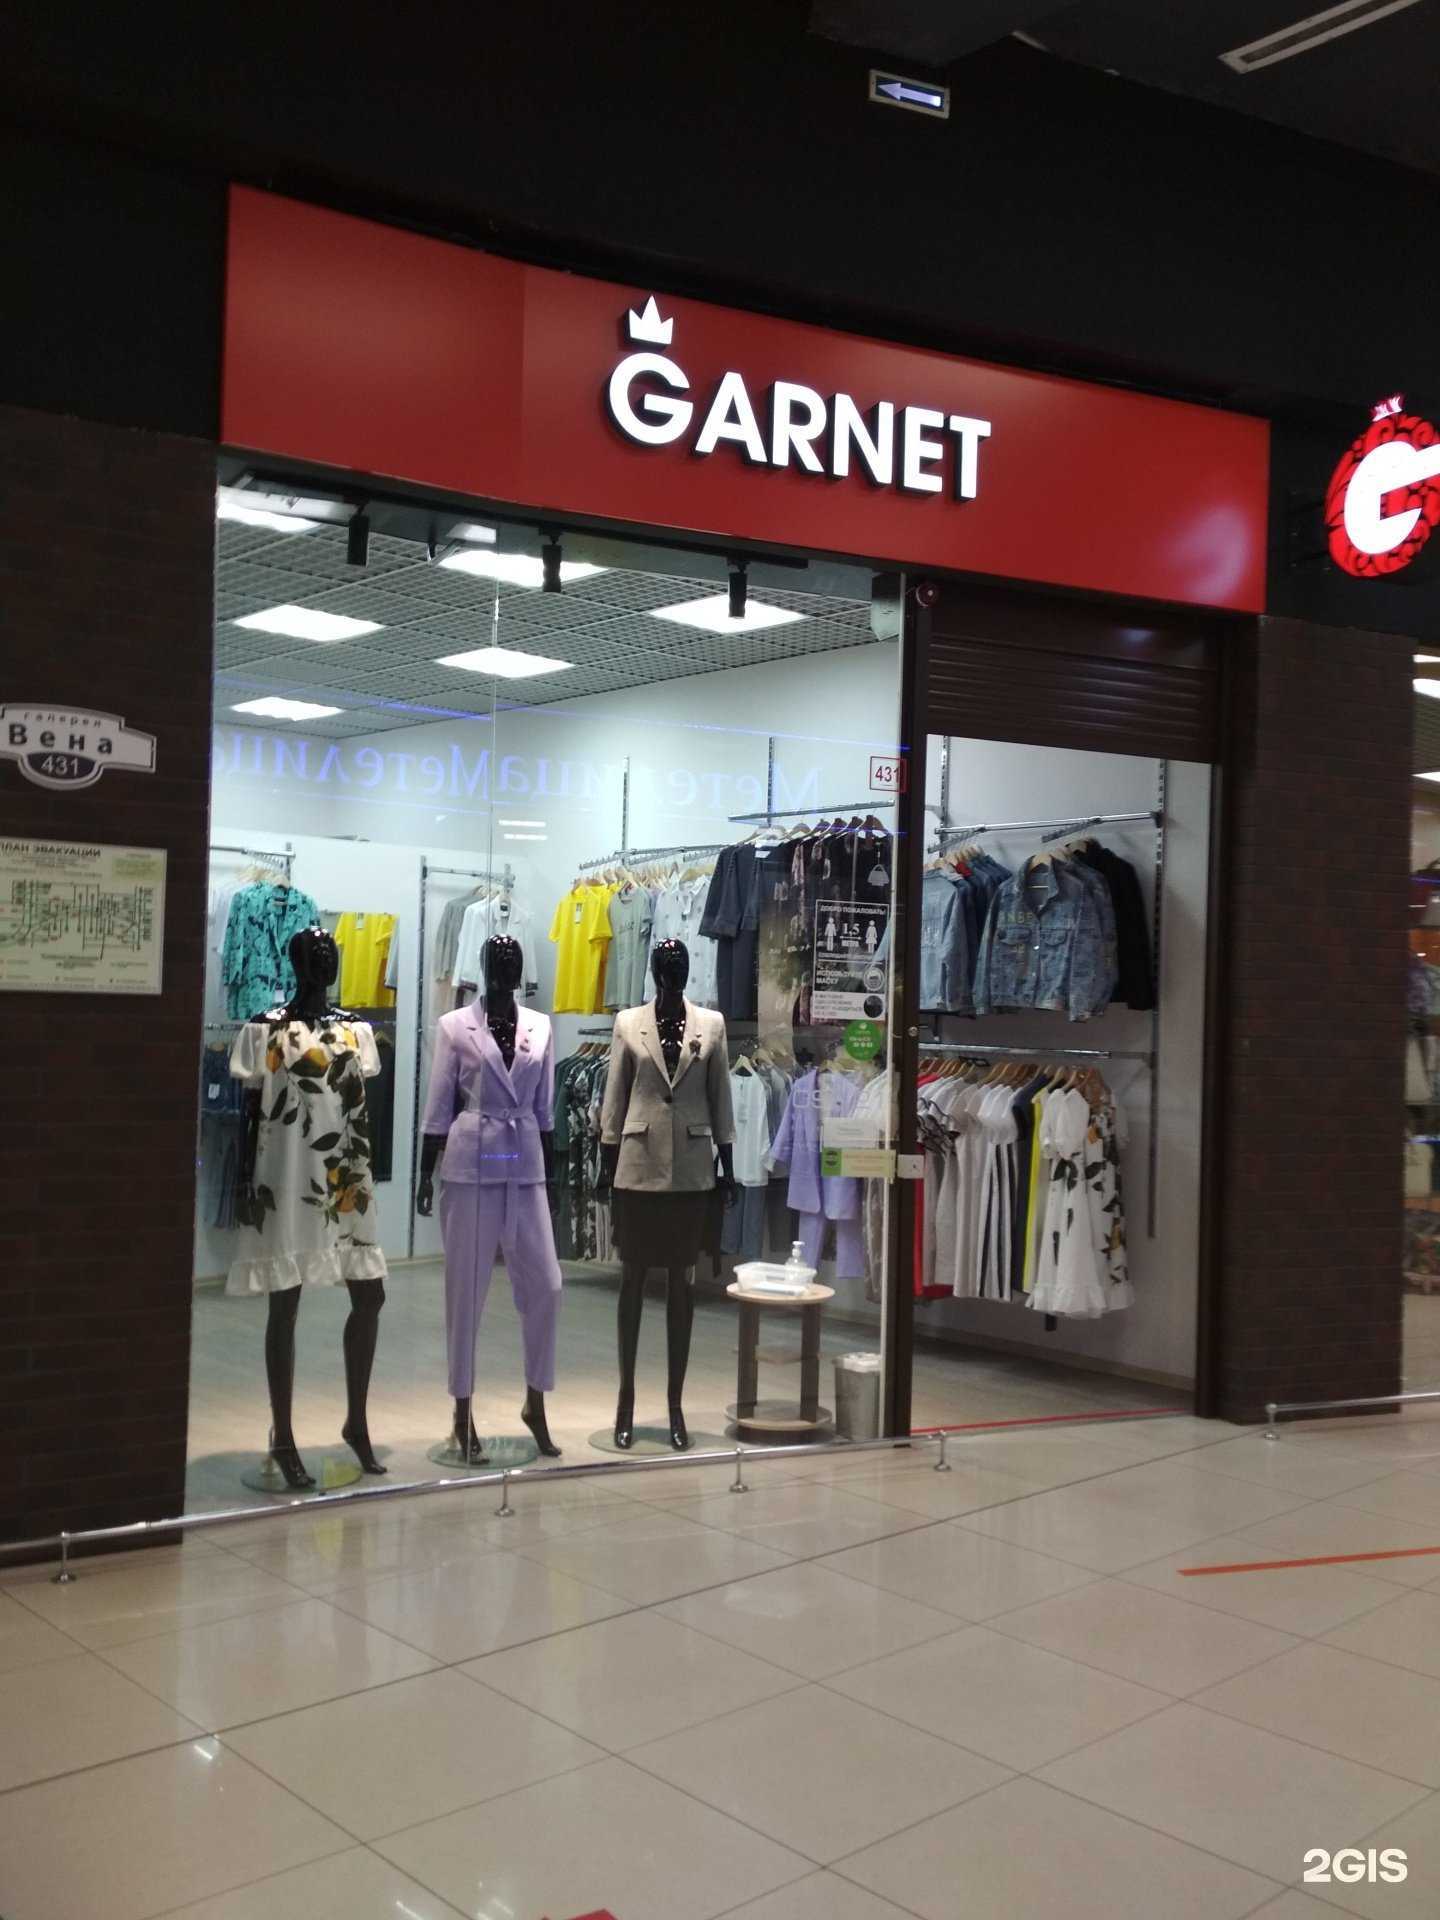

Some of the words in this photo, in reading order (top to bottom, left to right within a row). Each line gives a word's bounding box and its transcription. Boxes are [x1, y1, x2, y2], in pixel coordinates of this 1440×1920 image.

[608, 352, 991, 500] GARNET
[8, 723, 113, 754] Вена
[40, 754, 79, 777] 431
[875, 765, 900, 783] 431
[843, 922, 860, 936] 1,5
